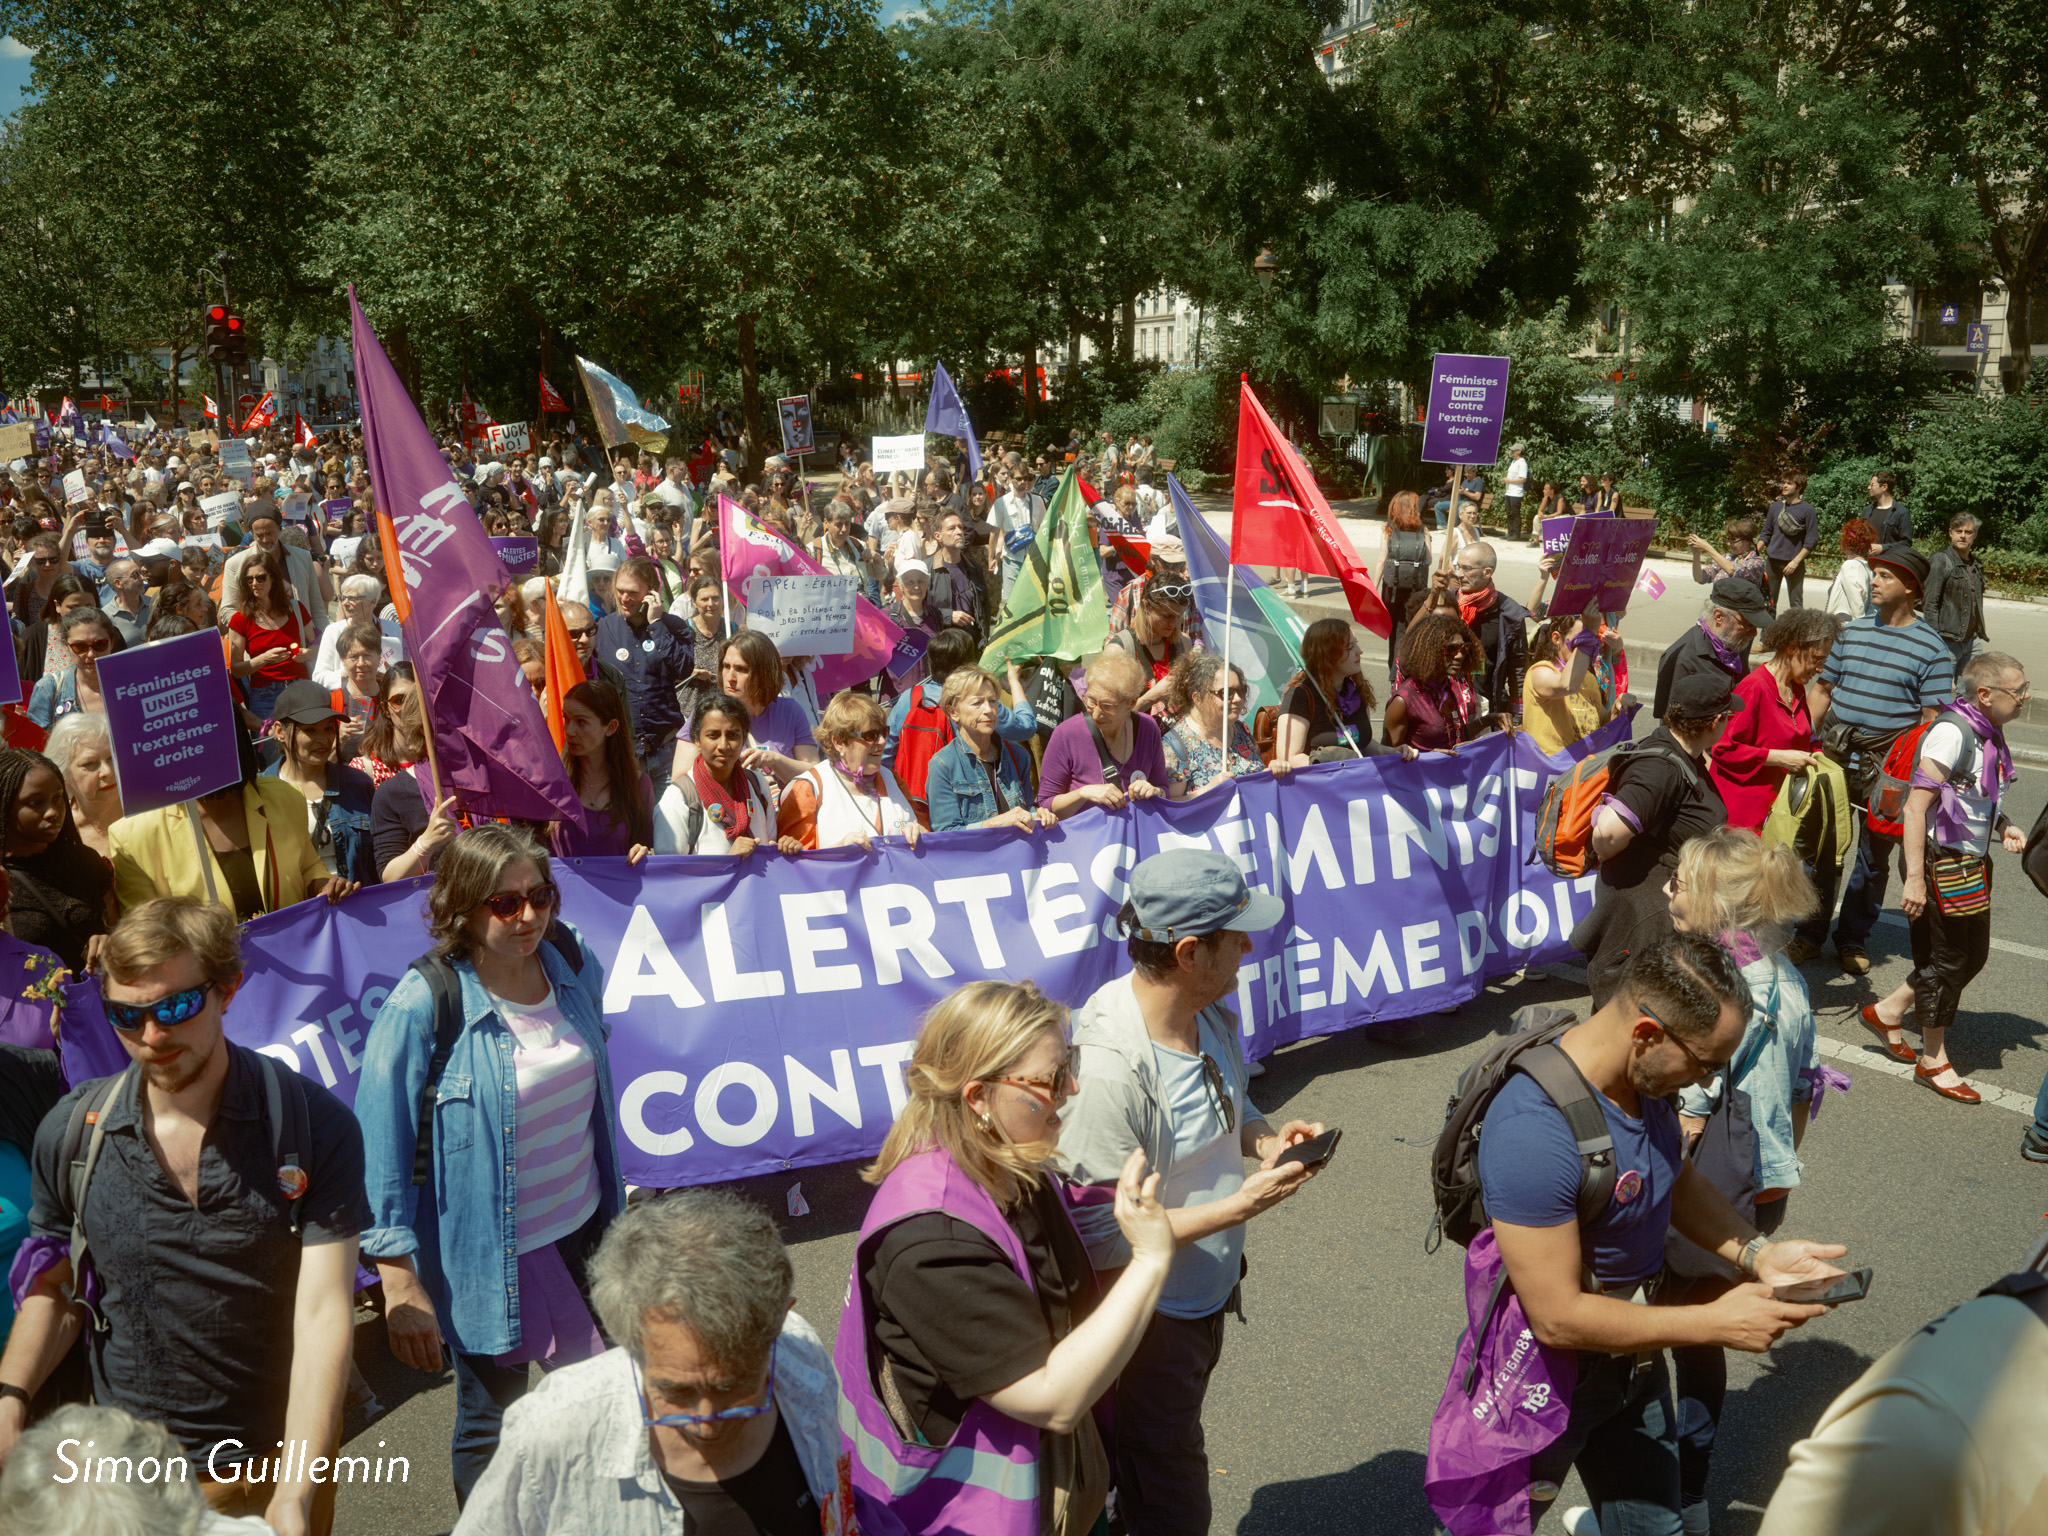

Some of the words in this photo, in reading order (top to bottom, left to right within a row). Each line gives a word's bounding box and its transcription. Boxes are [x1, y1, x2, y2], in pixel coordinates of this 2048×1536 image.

[1439, 374, 1498, 386] Féministes
[1453, 389, 1485, 399] UNIES
[1448, 402, 1483, 411] contre
[1438, 412, 1492, 424] l'extrême-
[491, 423, 527, 443] FUCK
[1447, 426, 1480, 436] droite
[494, 438, 521, 455] NO!
[497, 550, 536, 565] MINISTES
[502, 546, 526, 555] ALERTES
[762, 578, 796, 594] APEL
[812, 577, 854, 590] ÉGALITÉ
[757, 608, 781, 619] POUR
[767, 631, 780, 639] TRE
[115, 664, 211, 700] Féministes
[144, 688, 195, 713] UNIES
[142, 708, 199, 732] contre
[132, 721, 219, 756] l'extrême-
[153, 744, 204, 768] droite
[165, 775, 202, 792] FÉMINISTES
[173, 776, 193, 786] ALERTES
[602, 842, 1137, 1014] ALERTES
[1157, 767, 1560, 896] ÉMINIST
[619, 1040, 914, 1156] CONT
[1238, 919, 1446, 1037] TRÊME
